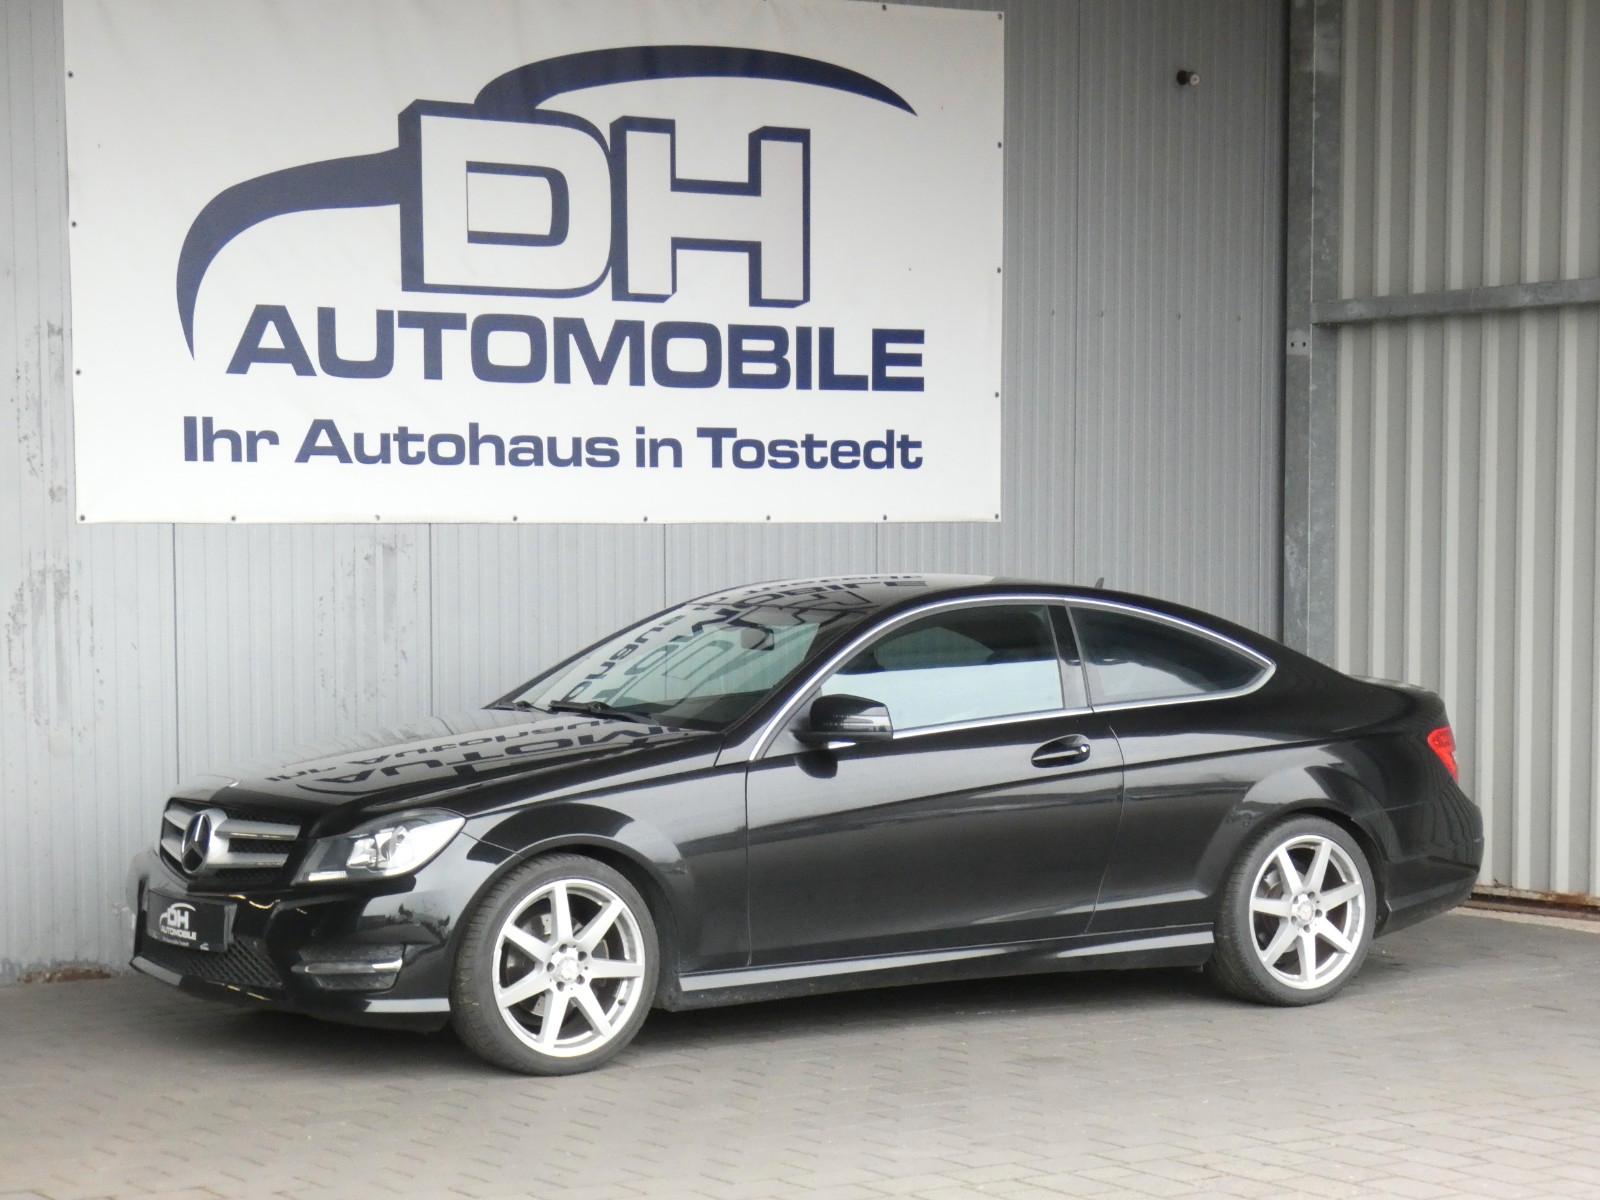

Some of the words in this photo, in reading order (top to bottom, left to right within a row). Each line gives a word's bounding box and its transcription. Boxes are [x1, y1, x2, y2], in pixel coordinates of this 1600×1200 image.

[398, 99, 810, 307] DH
[227, 305, 925, 392] AUTOMOBILE
[184, 416, 279, 463] Ihr
[297, 419, 620, 468] Autohaus
[636, 427, 683, 468] in
[696, 427, 923, 470] Tostedt
[161, 925, 197, 941] AUTOMOBILE
[167, 907, 189, 930] DH
